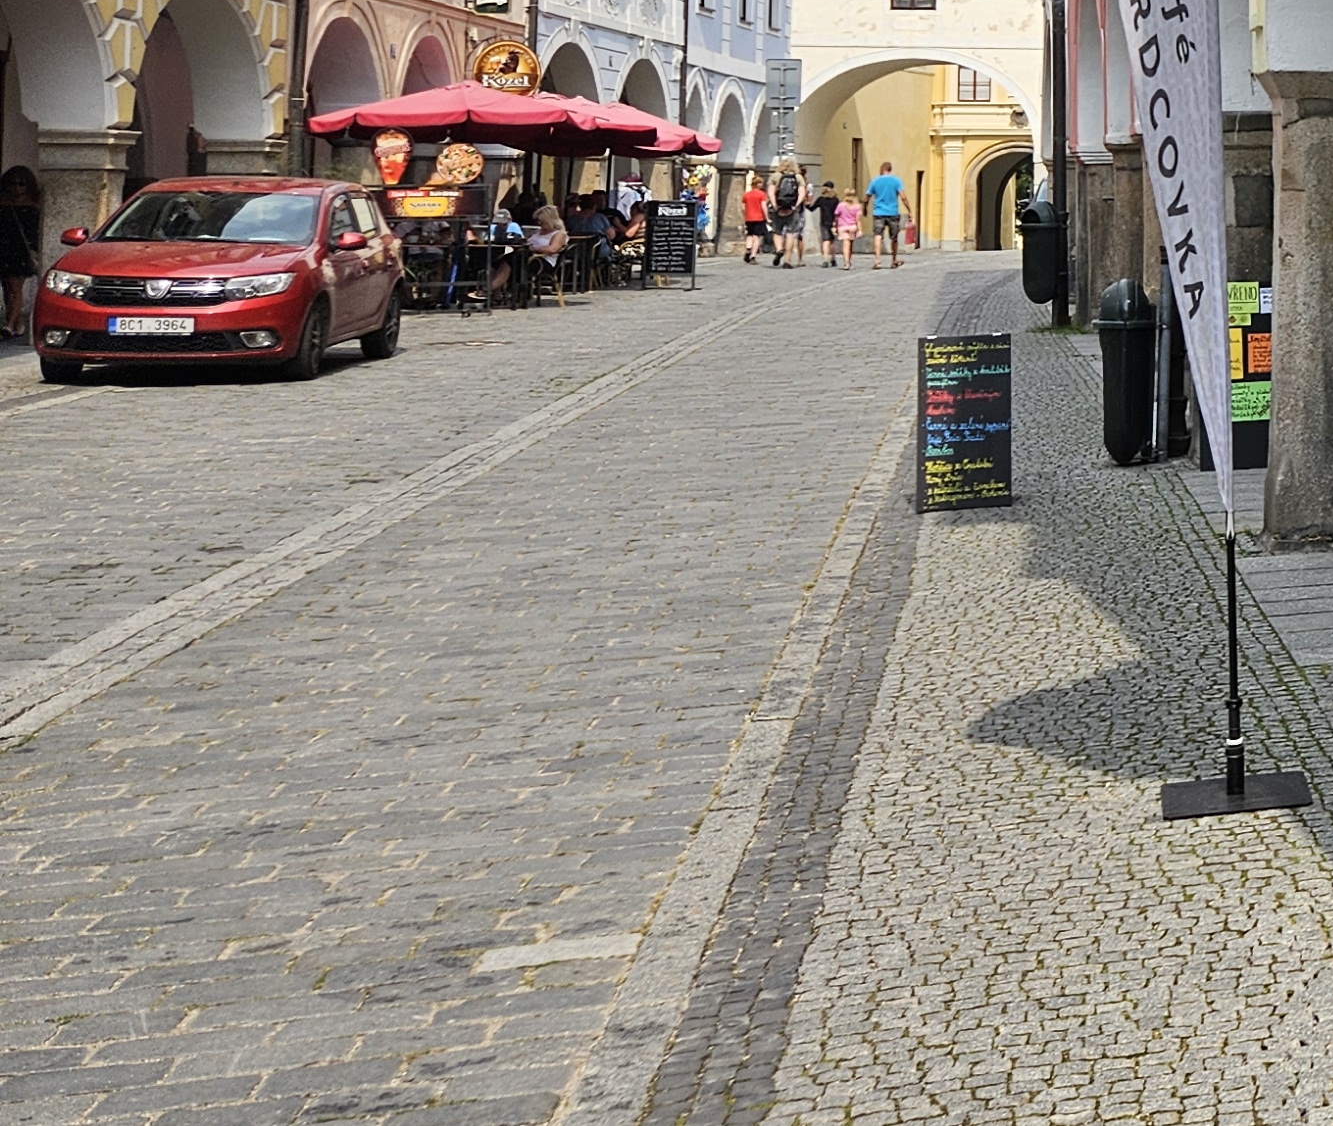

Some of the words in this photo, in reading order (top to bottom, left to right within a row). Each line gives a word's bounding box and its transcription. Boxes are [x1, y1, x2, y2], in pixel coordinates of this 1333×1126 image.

[481, 73, 531, 89] Kozel
[119, 318, 143, 331] 8C1
[154, 319, 187, 331] 3964
